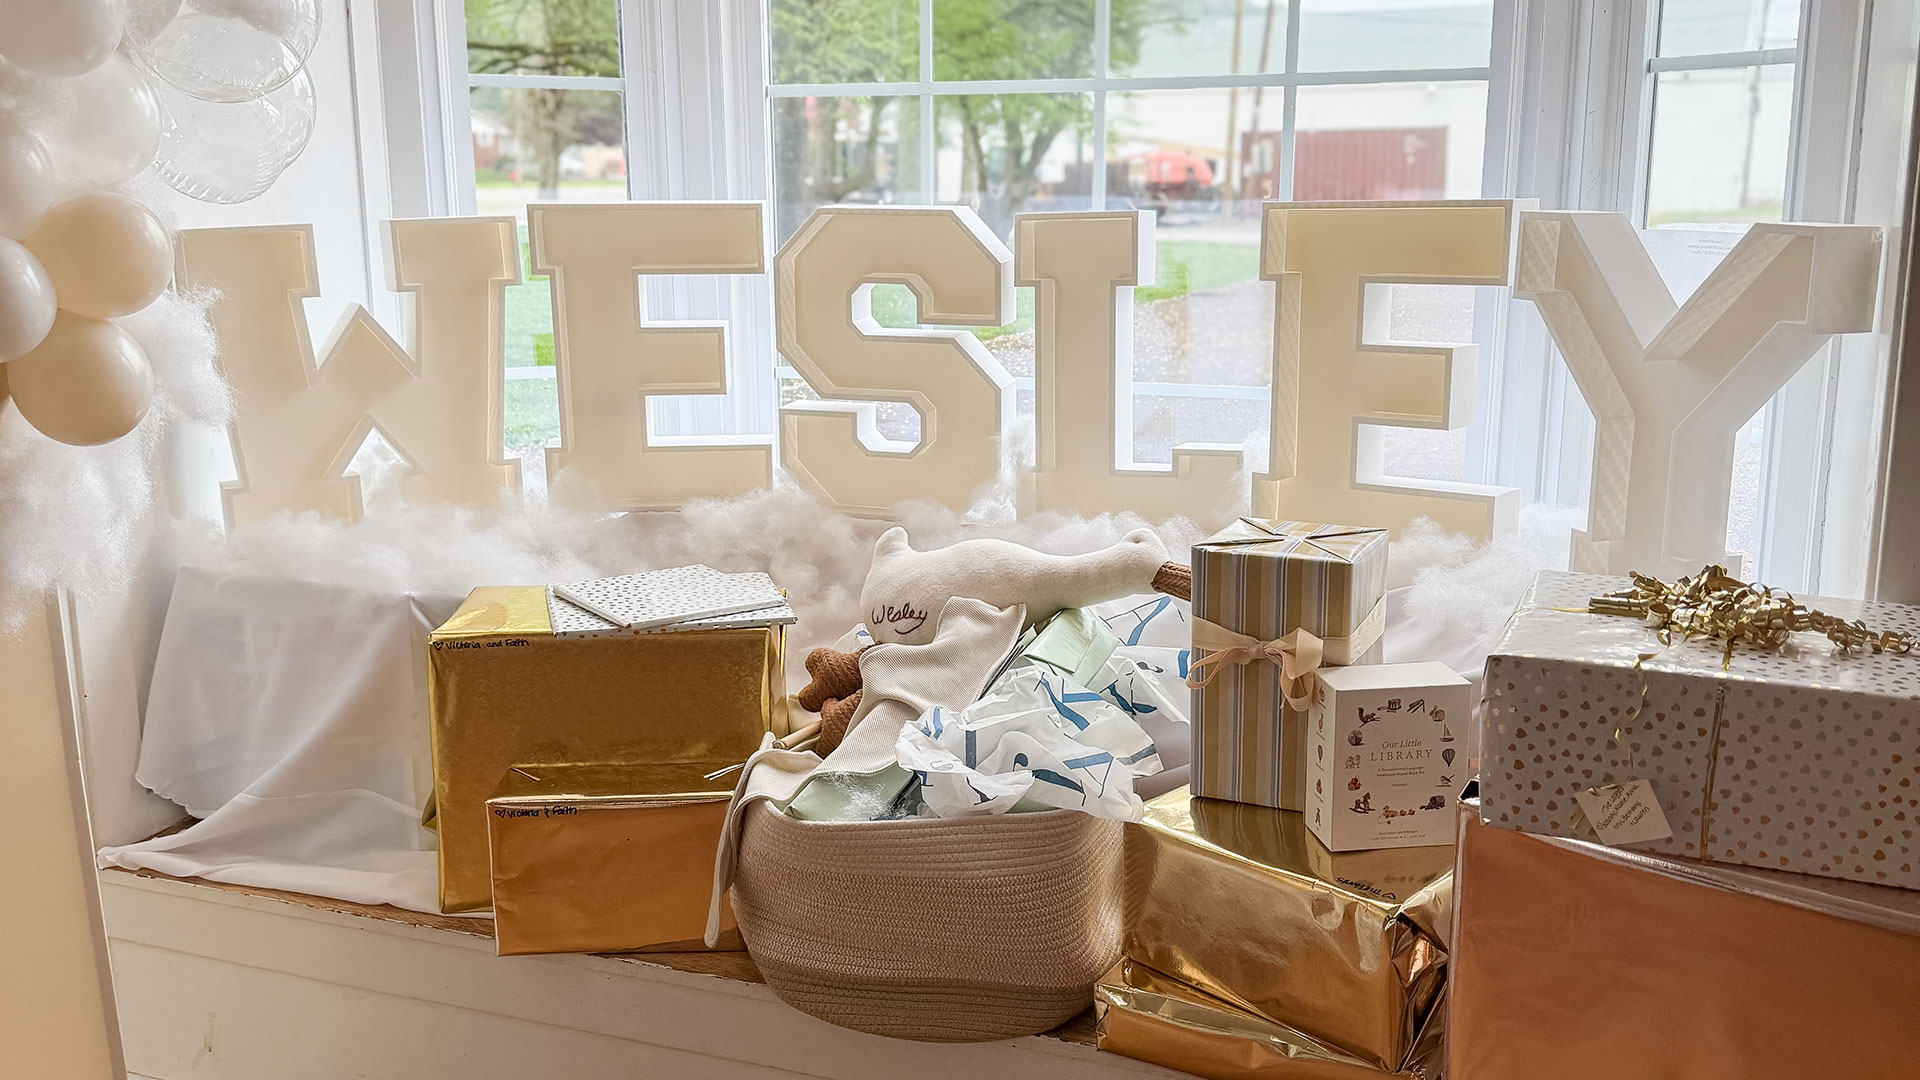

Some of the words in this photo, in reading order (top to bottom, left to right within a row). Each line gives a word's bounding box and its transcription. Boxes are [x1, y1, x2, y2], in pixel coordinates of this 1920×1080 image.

[175, 199, 1882, 572] WESLEY
[871, 601, 928, 635] Wesley
[445, 640, 481, 650] Victoria
[486, 640, 503, 648] and
[505, 638, 530, 648] Faith
[1381, 740, 1398, 749] Our
[1399, 739, 1422, 748] Little
[1370, 748, 1433, 762] LIBRARY
[552, 805, 577, 815] Faith
